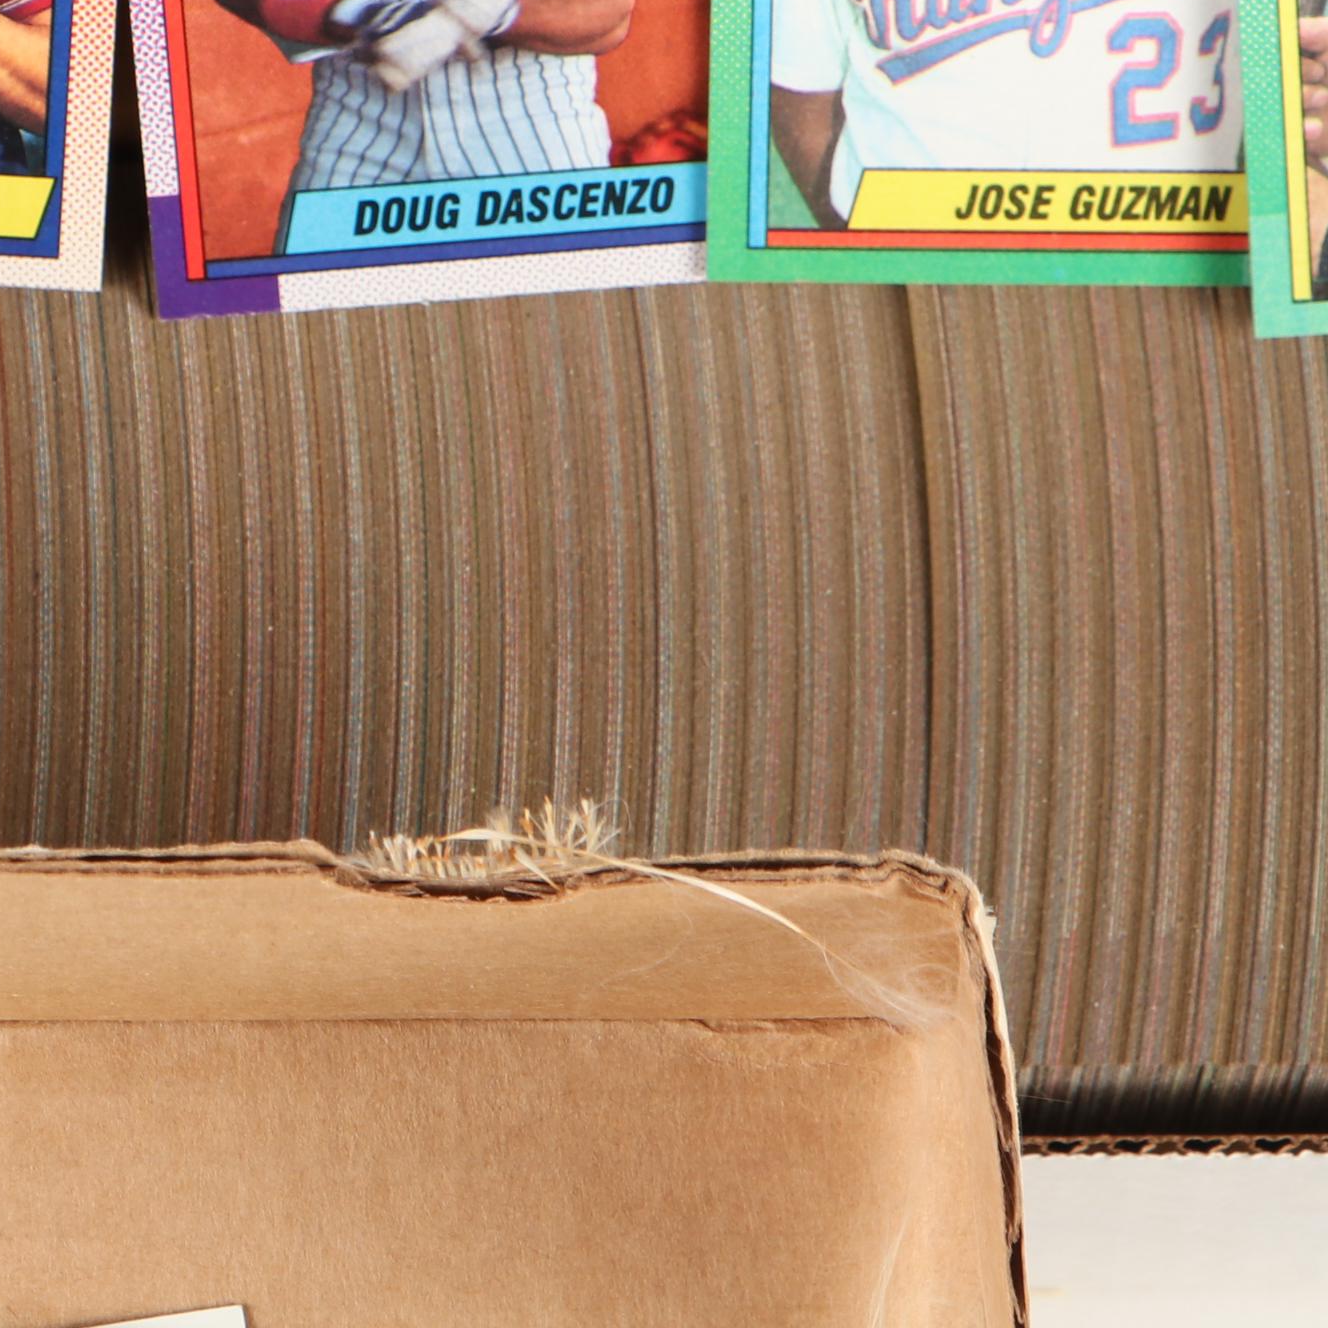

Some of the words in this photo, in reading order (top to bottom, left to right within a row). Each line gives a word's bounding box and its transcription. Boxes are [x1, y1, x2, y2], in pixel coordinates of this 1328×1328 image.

[1107, 9, 1232, 149] 23
[353, 192, 461, 236] DOUG
[475, 176, 675, 227] DASCENZO
[955, 184, 1055, 221] JOSE
[1069, 184, 1235, 224] GUZMAN
